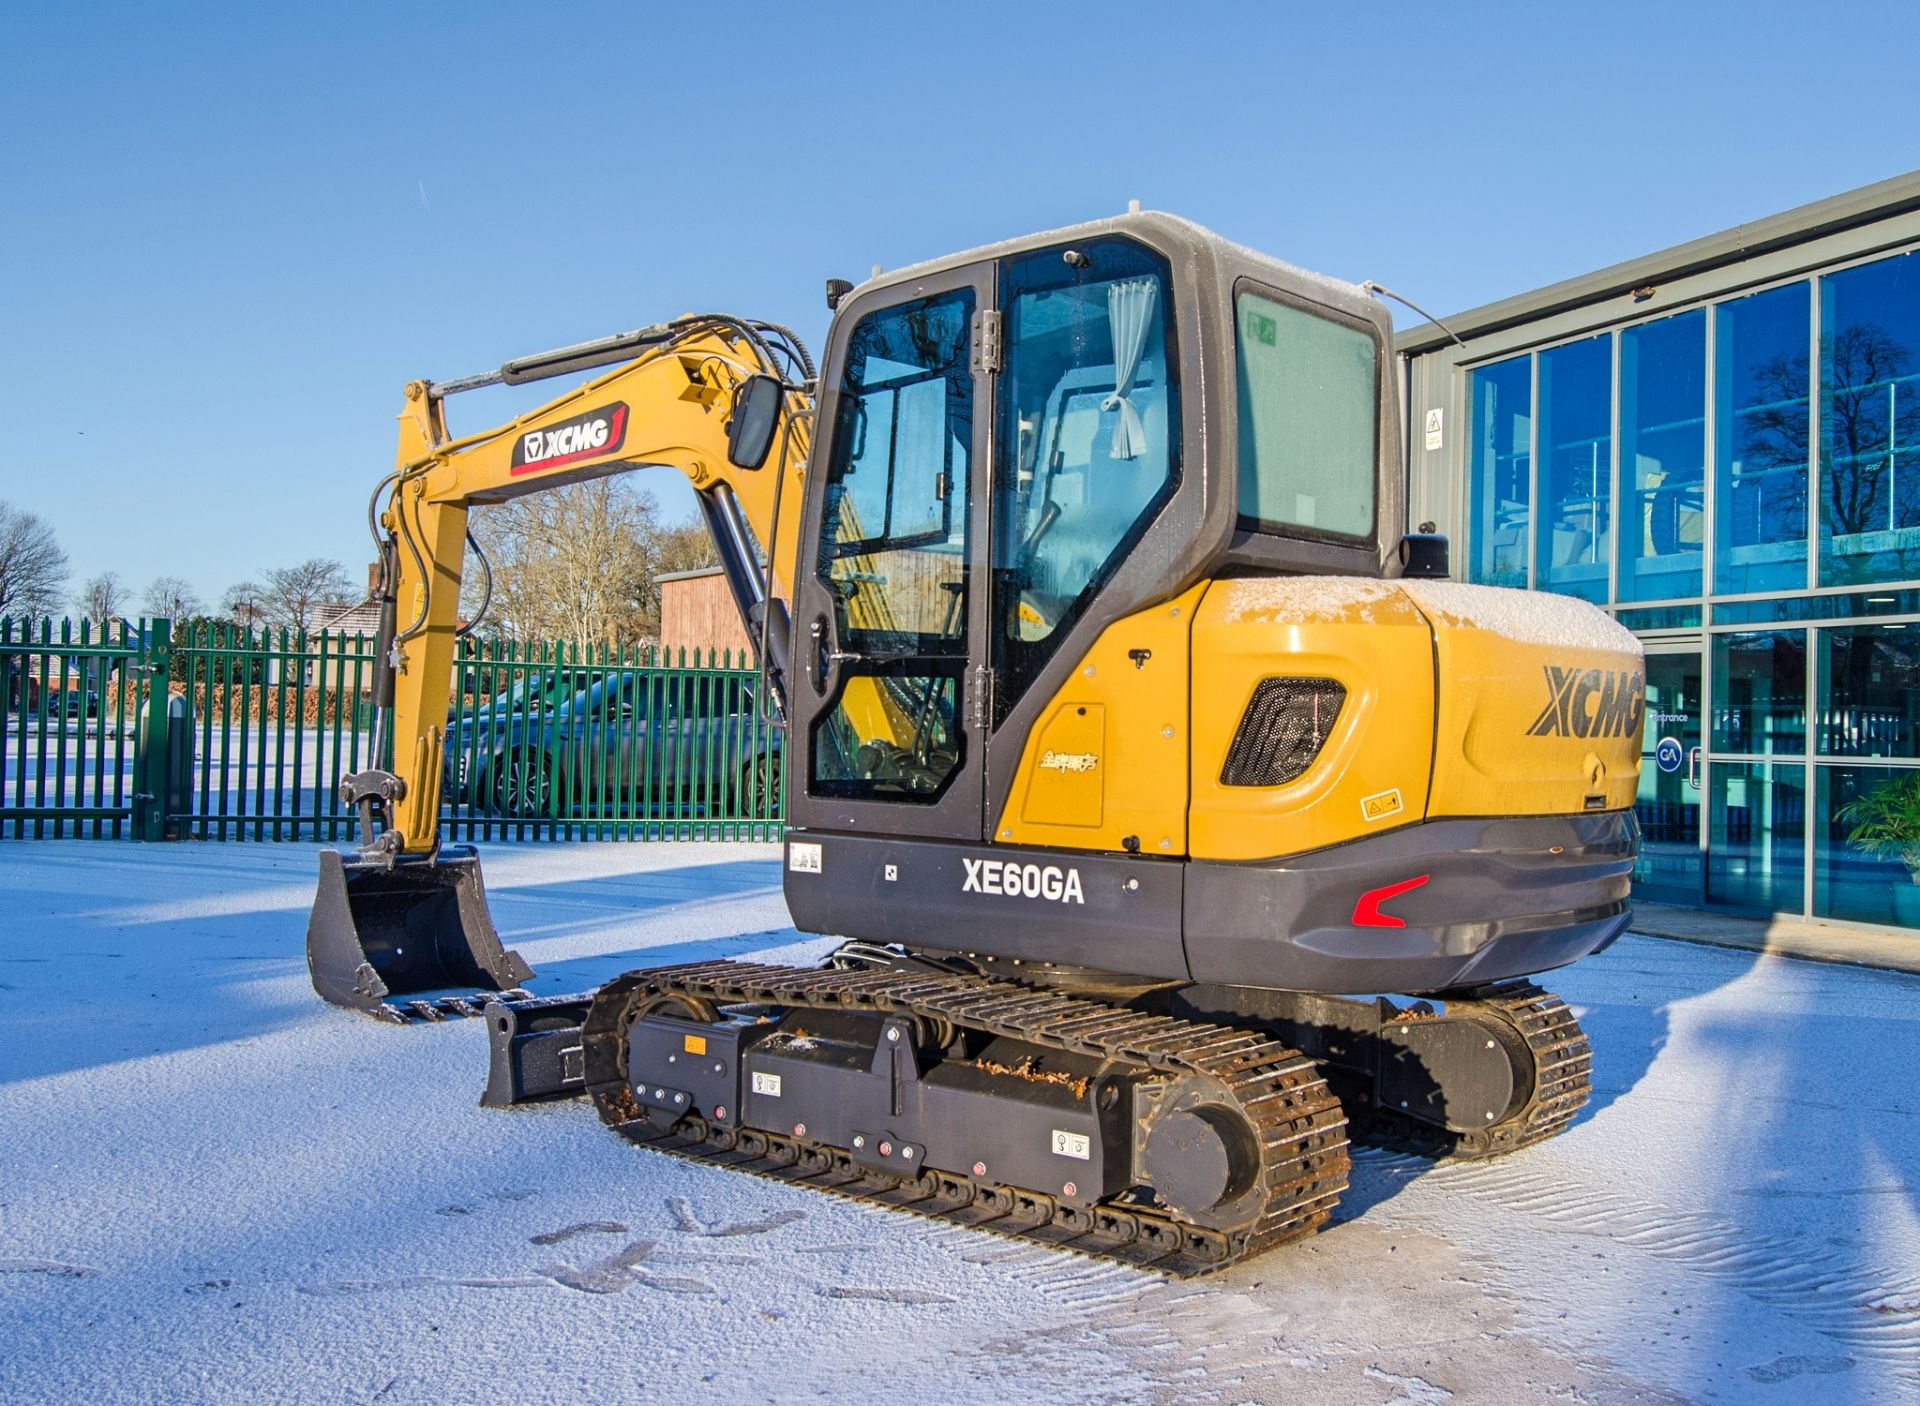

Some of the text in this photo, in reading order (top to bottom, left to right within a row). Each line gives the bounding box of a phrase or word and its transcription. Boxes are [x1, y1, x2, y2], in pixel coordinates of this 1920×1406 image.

[543, 419, 608, 458] XCMG
[1525, 665, 1643, 739] XCMG
[962, 858, 1085, 904] XE60GA
